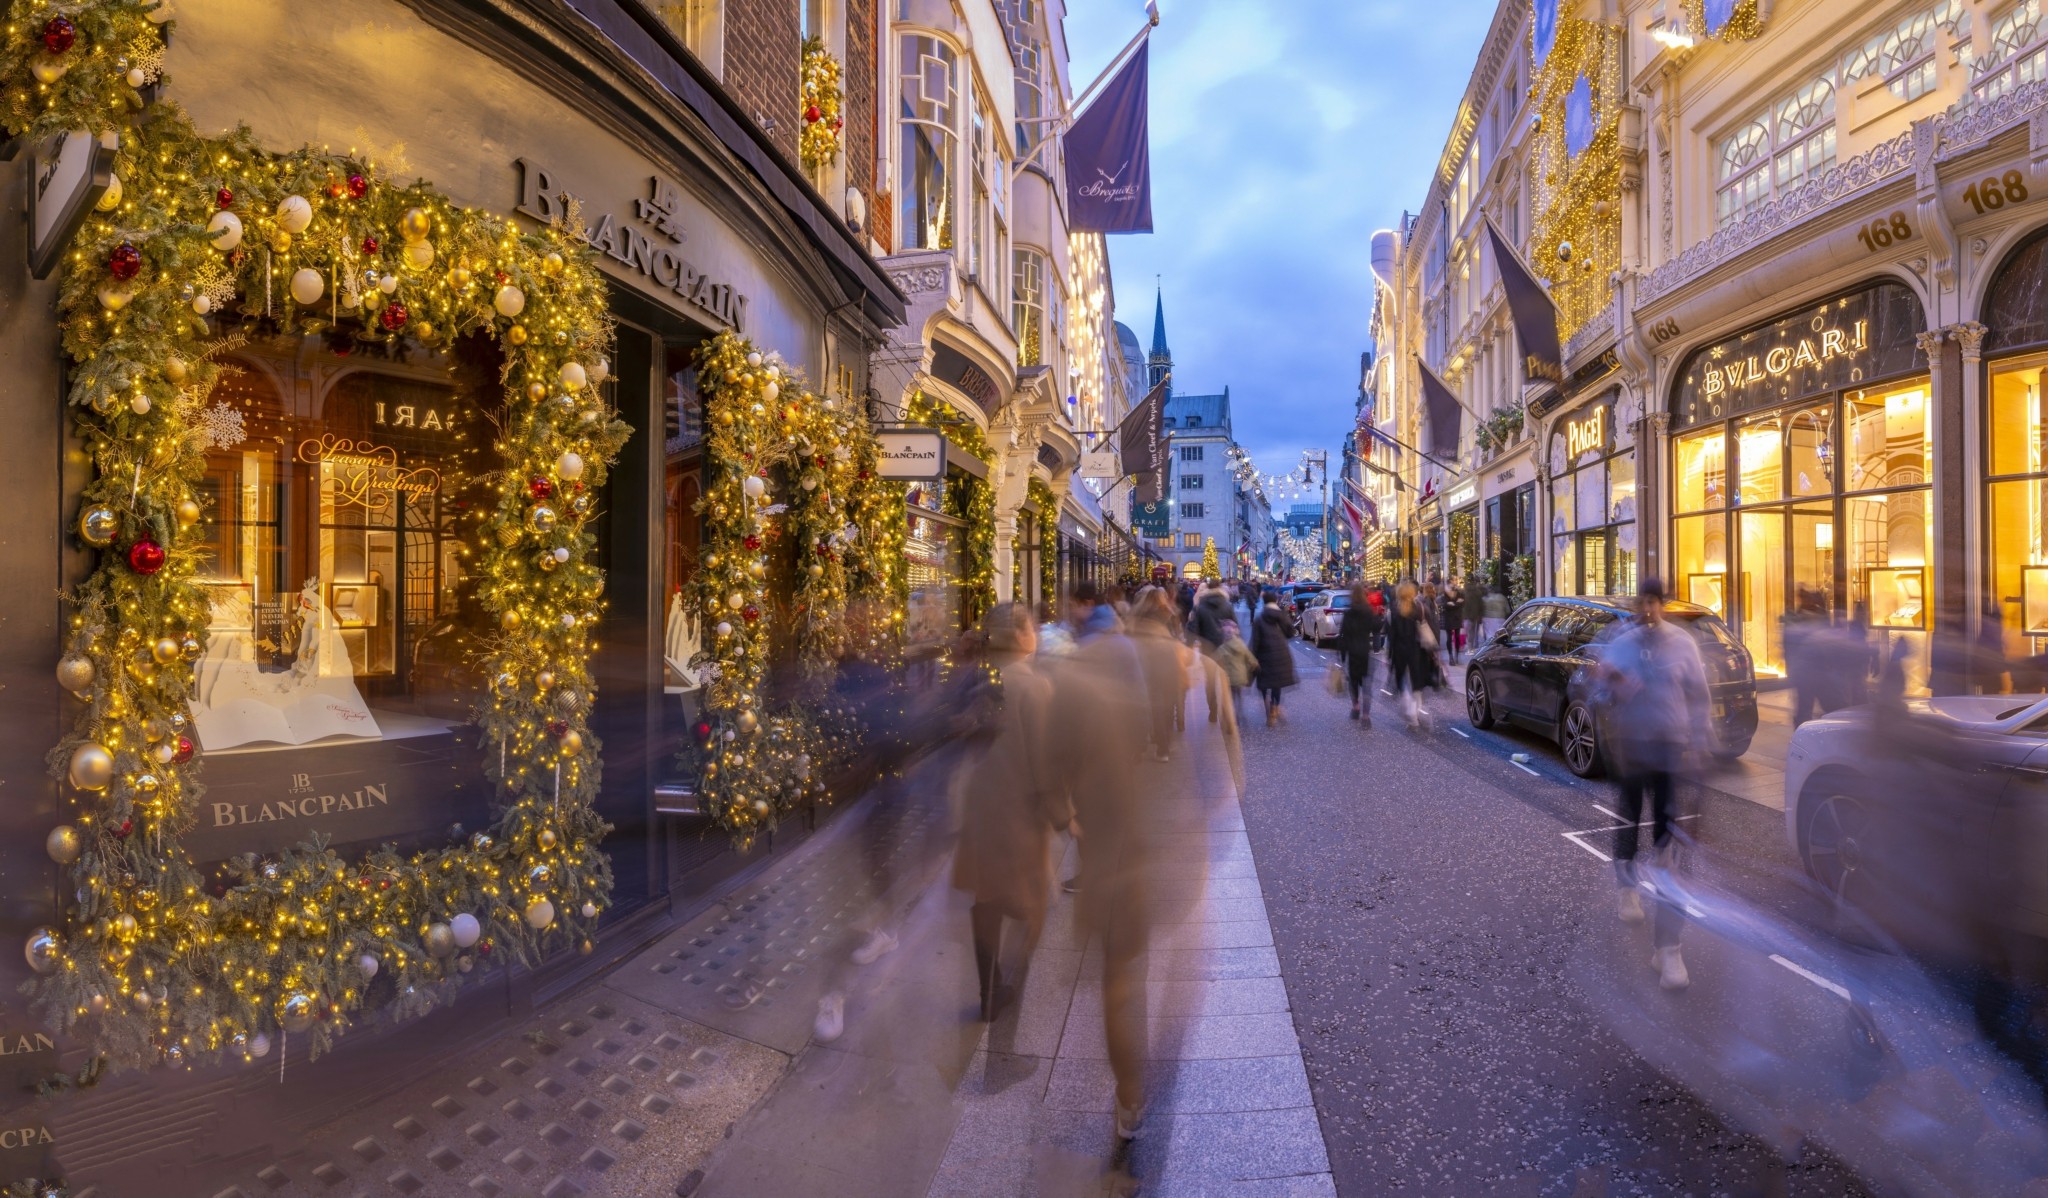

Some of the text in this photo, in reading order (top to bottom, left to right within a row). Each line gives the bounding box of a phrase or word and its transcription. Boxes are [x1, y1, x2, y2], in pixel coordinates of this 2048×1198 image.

[1962, 169, 2029, 215] 168
[636, 197, 688, 244] 1735
[1857, 210, 1912, 253] 168
[1649, 315, 1680, 345] 168
[1601, 348, 1621, 370] 16
[1704, 320, 1868, 397] BVLGARI
[959, 366, 995, 404] BREGU
[298, 433, 397, 467] Season's
[1148, 432, 1157, 453] Cleef
[1568, 405, 1604, 460] PIAGET
[881, 451, 936, 459] BLANCPAIN
[320, 467, 441, 509] Greetings
[211, 783, 389, 827] BLANCPAIN
